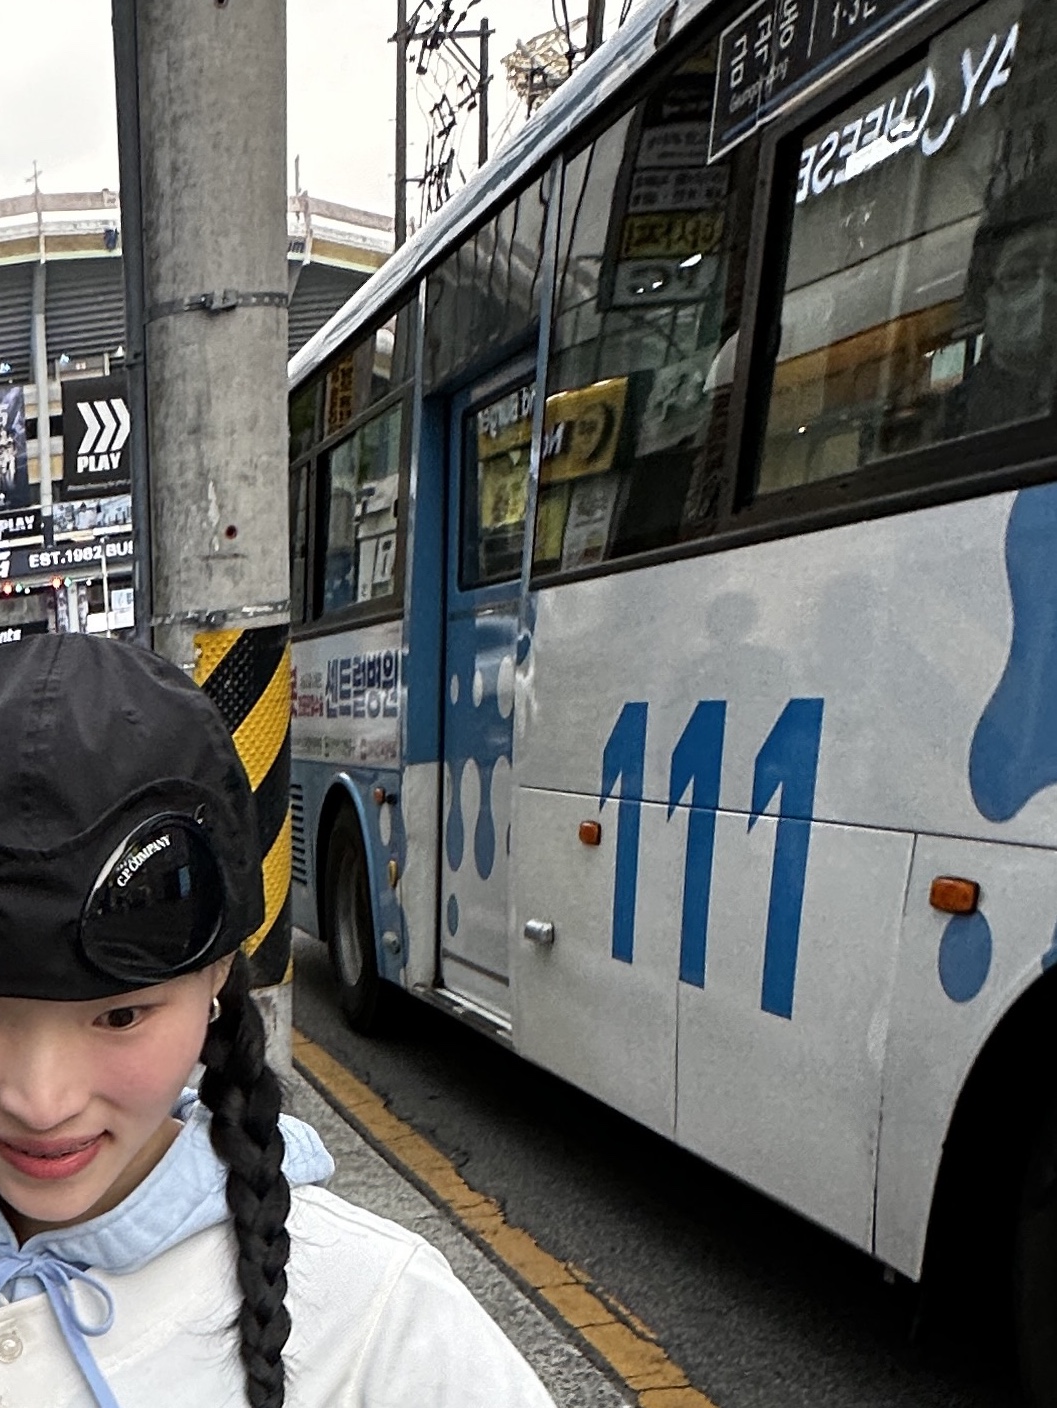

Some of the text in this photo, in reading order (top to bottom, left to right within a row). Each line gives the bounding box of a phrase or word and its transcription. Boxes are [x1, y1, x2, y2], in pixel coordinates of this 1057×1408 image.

[77, 452, 121, 474] PLAY
[128, 834, 171, 872] COMPANY
[598, 697, 825, 1020] 111
